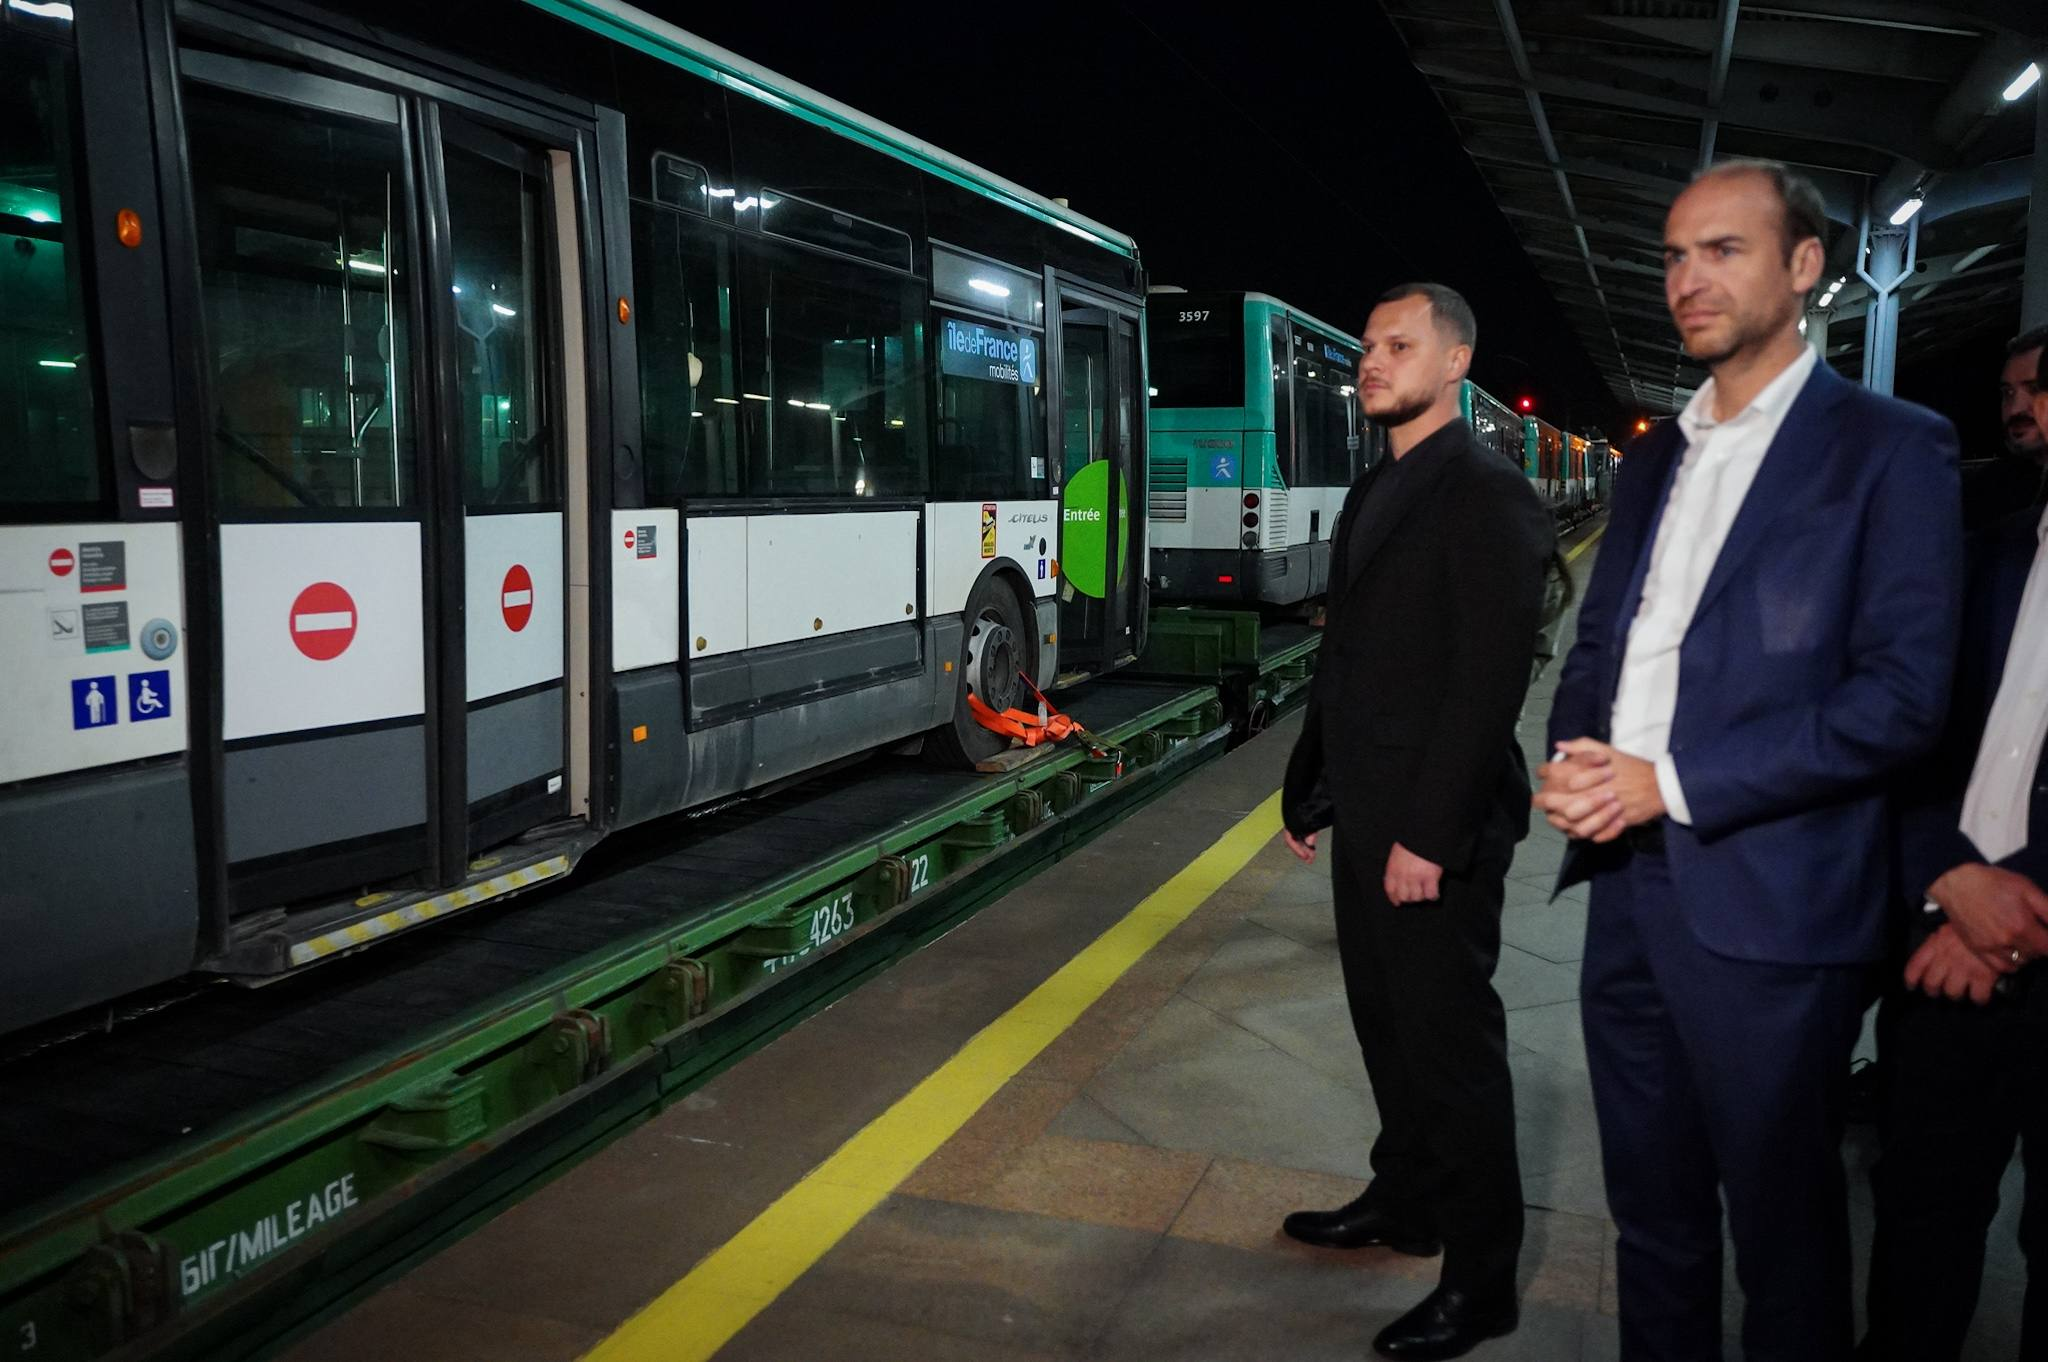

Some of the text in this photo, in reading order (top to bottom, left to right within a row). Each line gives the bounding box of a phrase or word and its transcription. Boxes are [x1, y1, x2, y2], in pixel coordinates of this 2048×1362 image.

[1178, 310, 1210, 322] 3597
[989, 363, 1019, 381] mobilités
[1063, 507, 1101, 521] Entrée
[911, 853, 929, 893] 22
[180, 1173, 358, 1295] БІГ/MILEAGE
